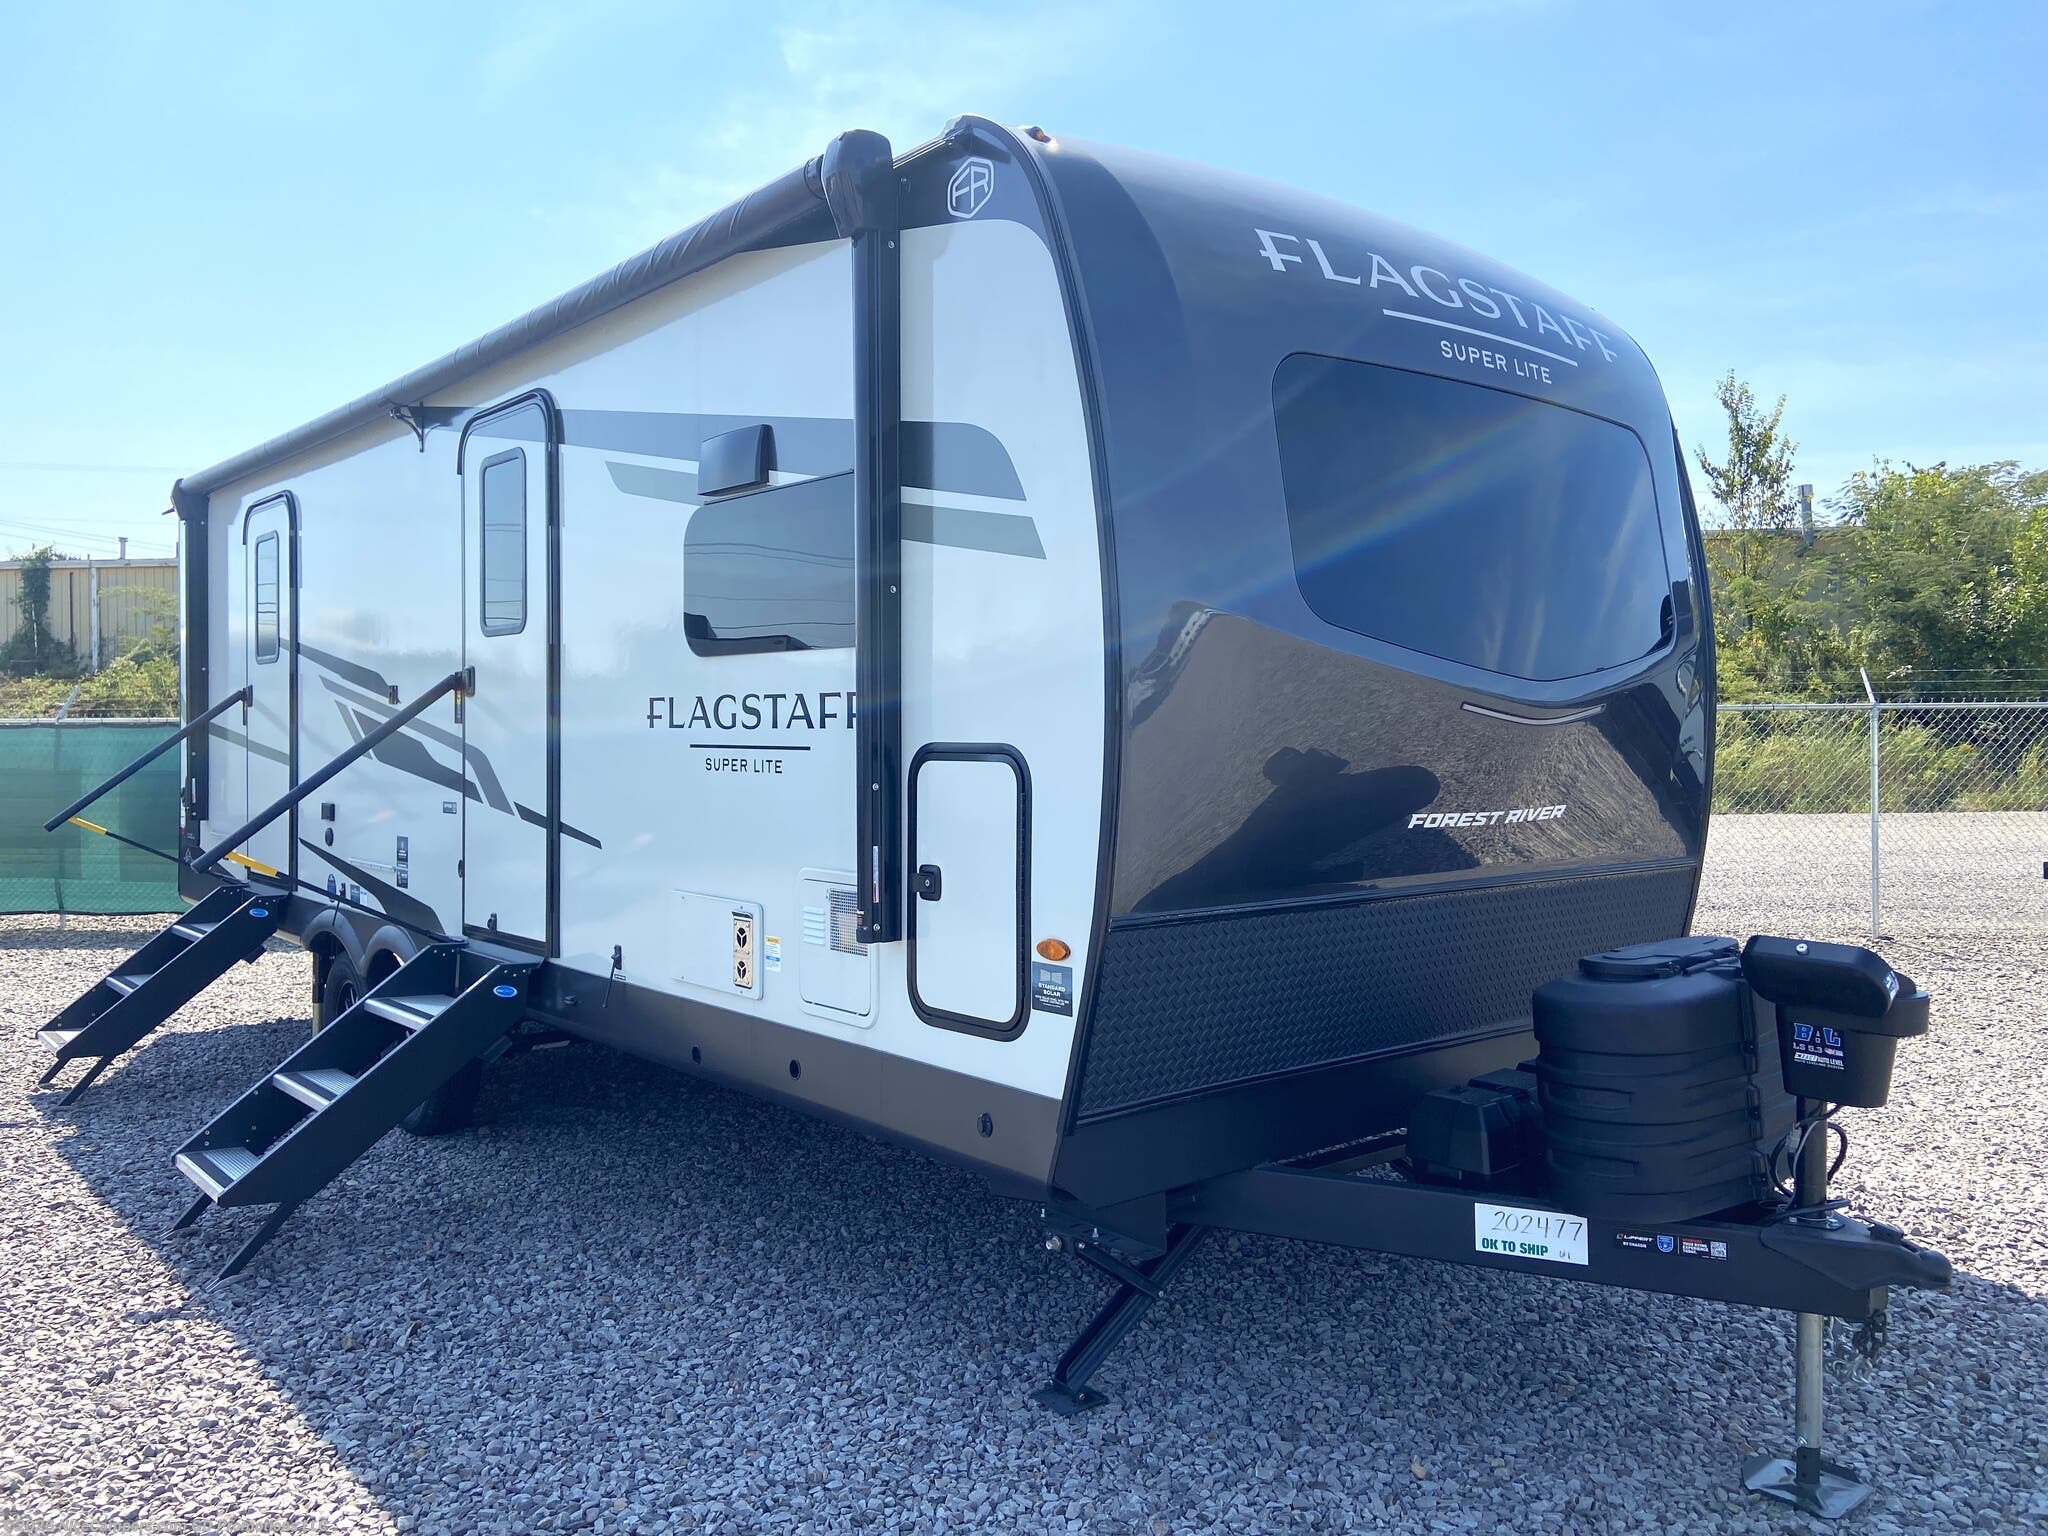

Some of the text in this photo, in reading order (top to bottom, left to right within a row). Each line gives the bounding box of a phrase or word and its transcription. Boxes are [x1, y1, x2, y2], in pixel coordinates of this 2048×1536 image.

[1254, 228, 1618, 362] FLAGSTAFF
[1440, 340, 1553, 385] SUPER LITE
[705, 757, 783, 774] SUPER LITE
[1407, 804, 1567, 829] FOREST RIVER
[1491, 1211, 1583, 1241] 202477
[1481, 1237, 1499, 1251] OK
[1501, 1240, 1516, 1253] TO
[1519, 1243, 1549, 1256] SHIP
